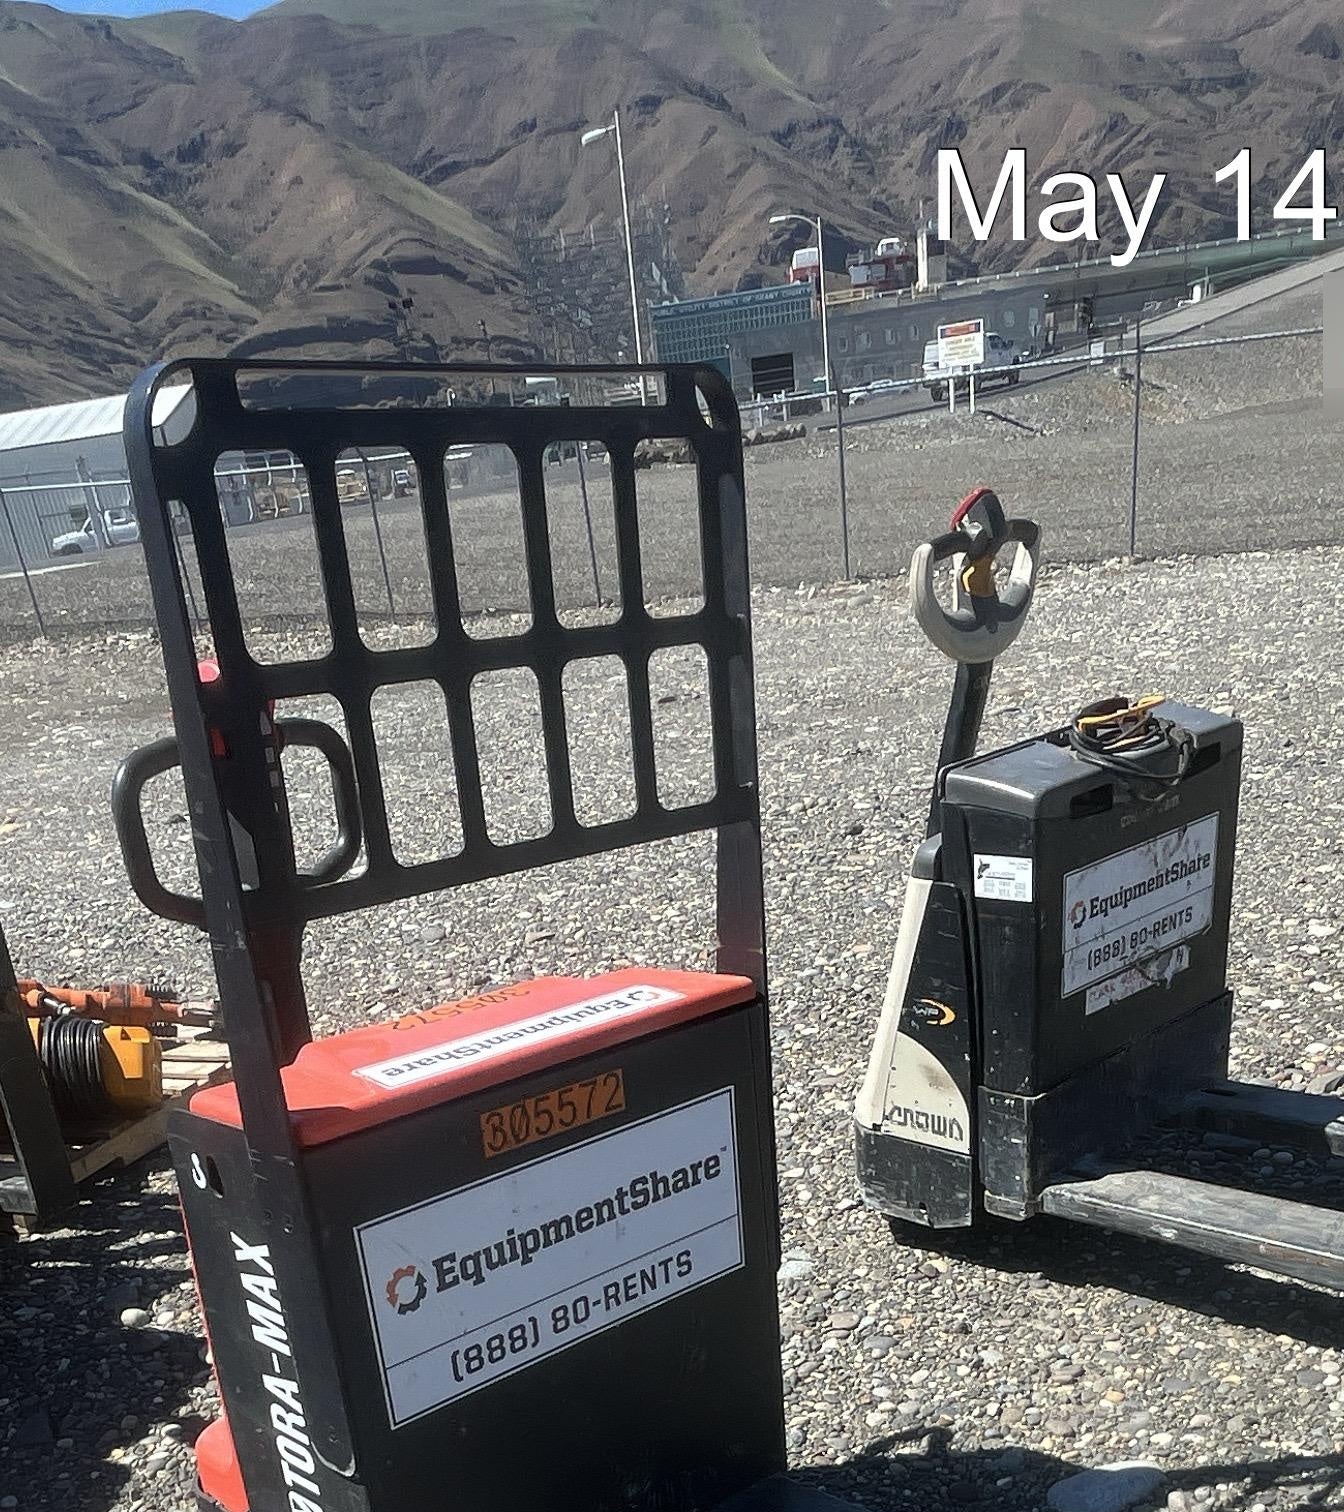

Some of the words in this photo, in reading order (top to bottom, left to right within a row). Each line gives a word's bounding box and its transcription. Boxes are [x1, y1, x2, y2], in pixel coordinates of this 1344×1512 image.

[1088, 852, 1212, 920] EquipmentShare
[1087, 935, 1126, 971] (888)
[1129, 905, 1193, 950] 80-RENTS
[382, 998, 633, 1078] EquipmentShare
[431, 1153, 722, 1293] EquipmentShare
[450, 1316, 541, 1383] (888)
[550, 1249, 693, 1335] 80-RENTS
